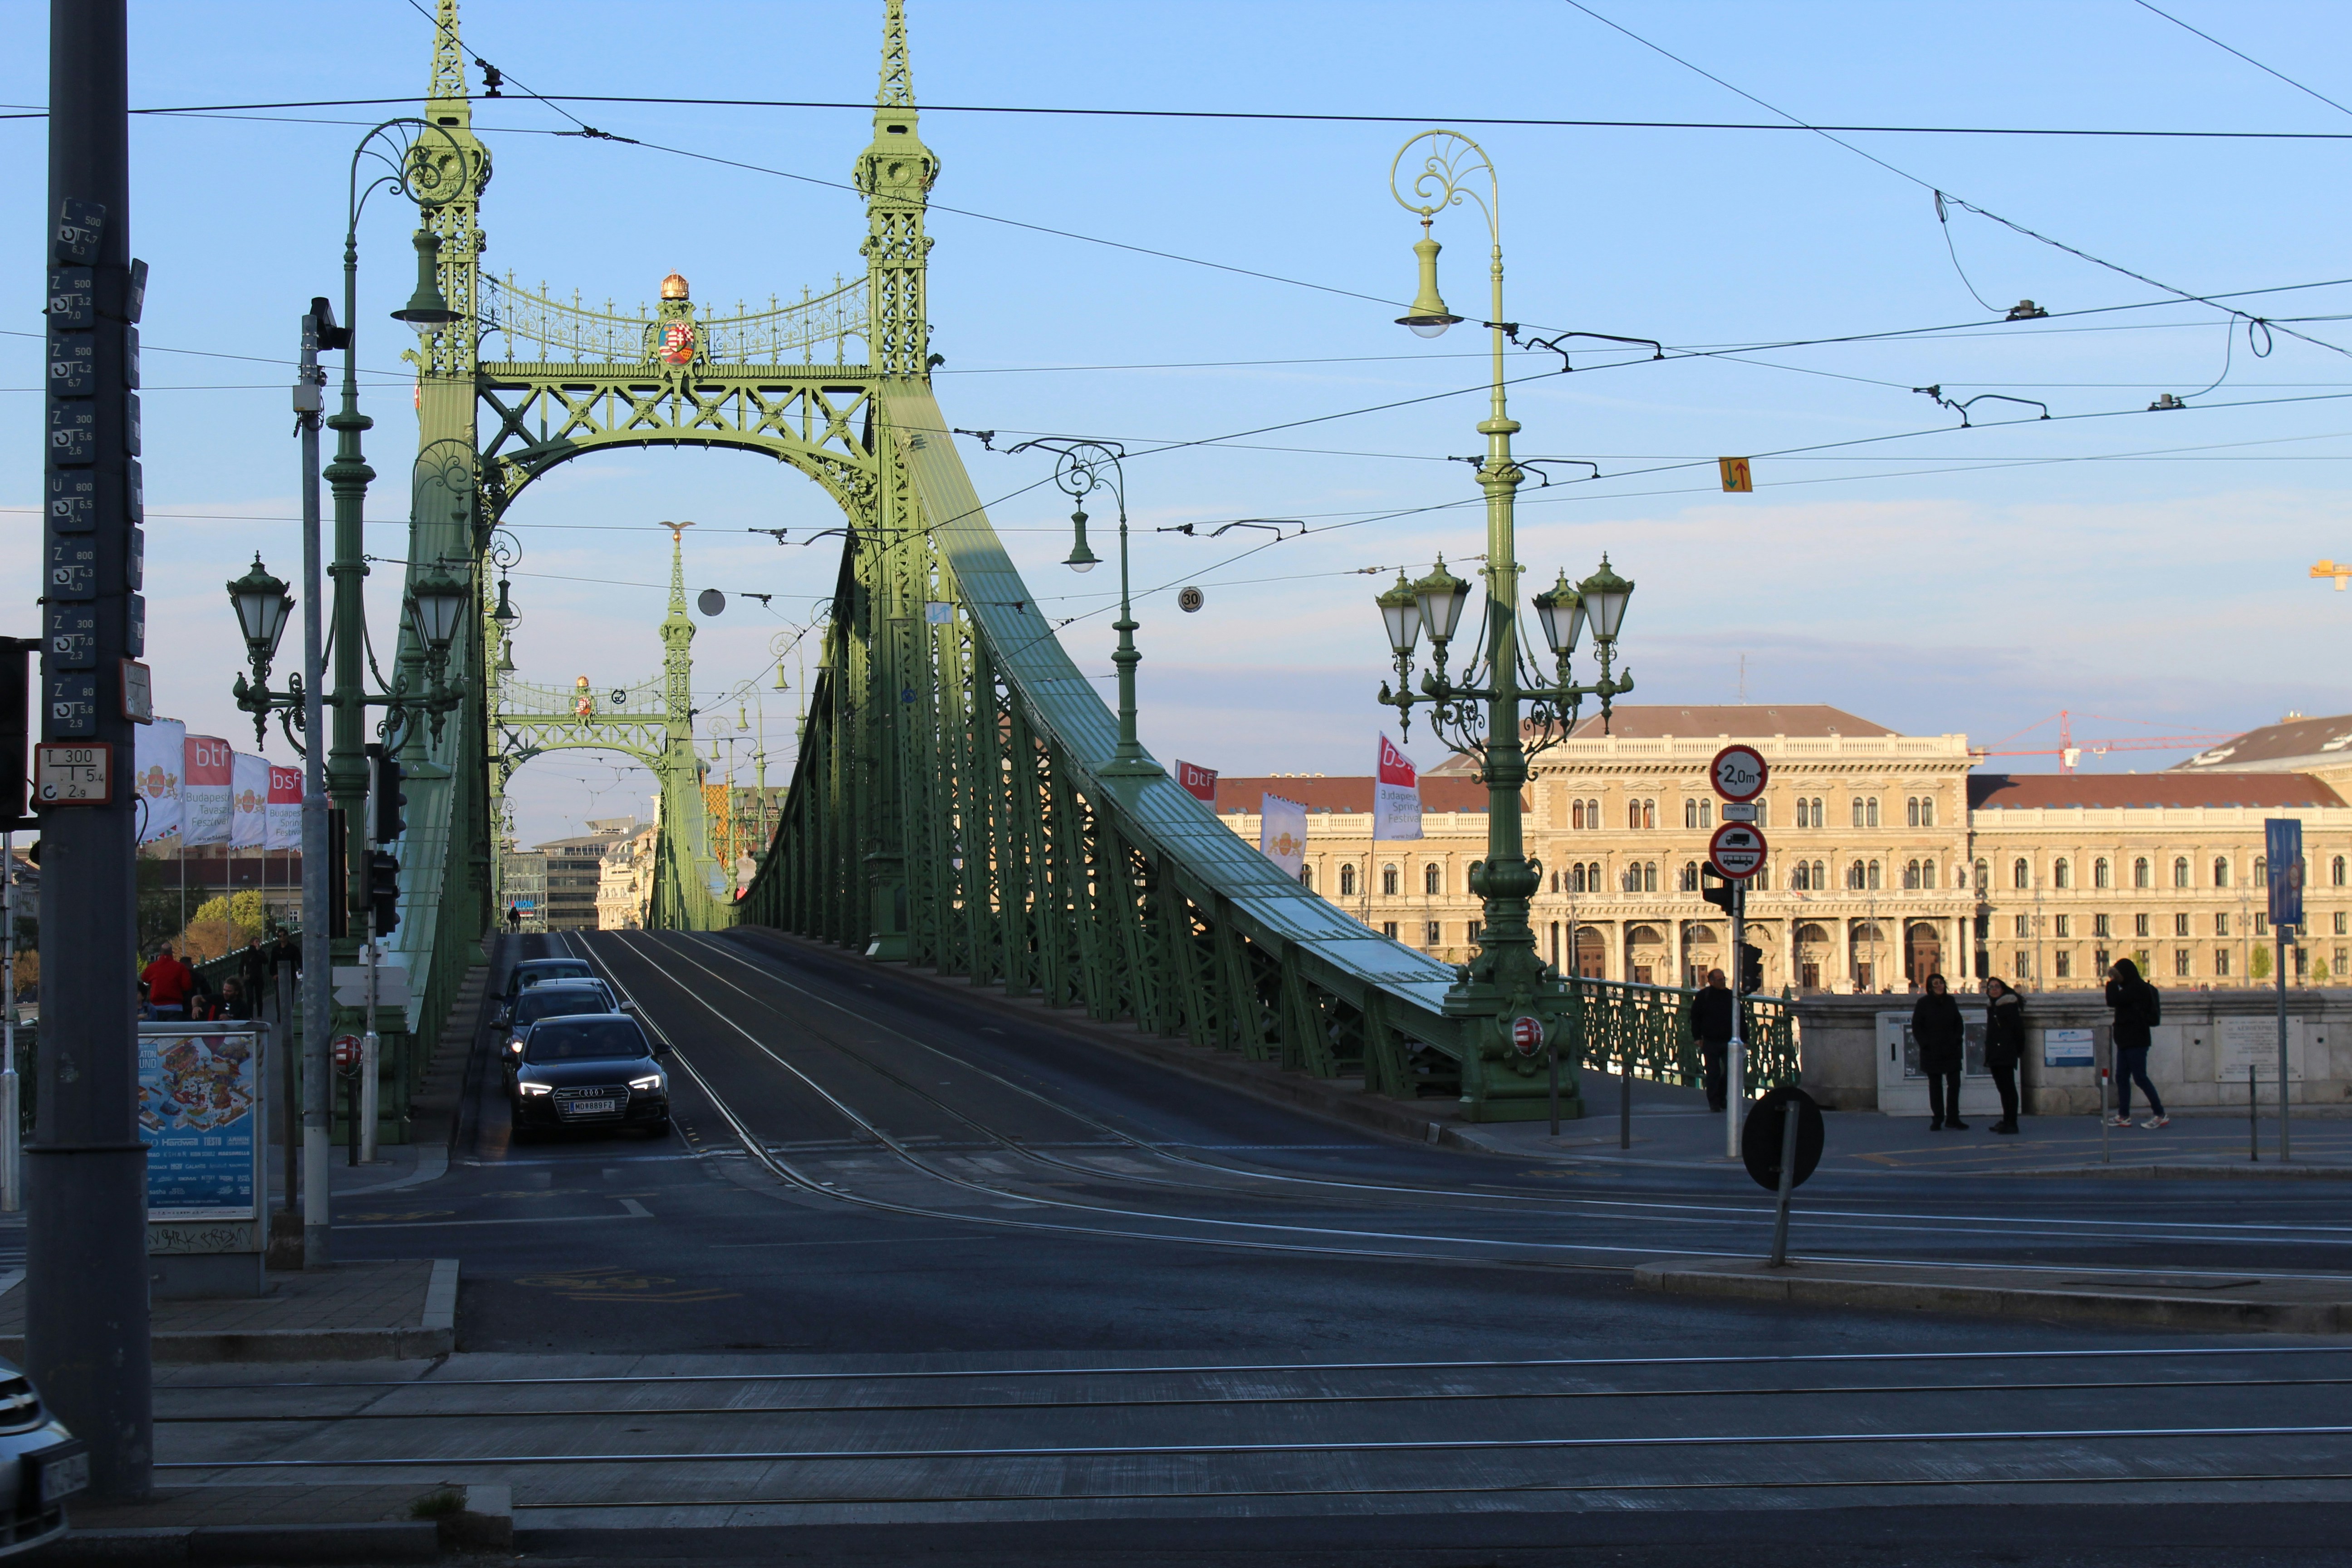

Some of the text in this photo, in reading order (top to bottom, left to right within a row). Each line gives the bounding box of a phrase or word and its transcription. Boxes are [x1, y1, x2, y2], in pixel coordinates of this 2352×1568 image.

[85, 216, 101, 227] 500
[84, 234, 98, 244] 4.7
[72, 245, 85, 255] 6.3
[52, 276, 91, 289] Z 500
[52, 343, 61, 357] Z
[78, 365, 92, 373] 4.2
[68, 379, 81, 387] 6.7
[53, 411, 92, 424] Z 300
[69, 447, 82, 455] 2.6
[53, 479, 92, 491] Ü 800
[79, 500, 93, 509] 6.5
[54, 548, 62, 560] Z
[1184, 593, 1198, 605] 30
[54, 616, 62, 628] Z
[54, 684, 63, 696] Z
[47, 750, 92, 762] T 300
[196, 742, 229, 767] btf
[1383, 743, 1411, 769] bs
[86, 769, 103, 781] 5.4
[273, 770, 301, 789] bsf
[1188, 767, 1213, 787] btf
[69, 785, 85, 798] 2.9
[186, 792, 230, 803] Budapesti
[200, 805, 229, 814] Tavaszi
[1393, 802, 1419, 813] Spring
[270, 810, 301, 819] Budapes
[1388, 814, 1421, 823] Festival
[192, 818, 229, 827] Fesztivál
[139, 1059, 156, 1068] UND
